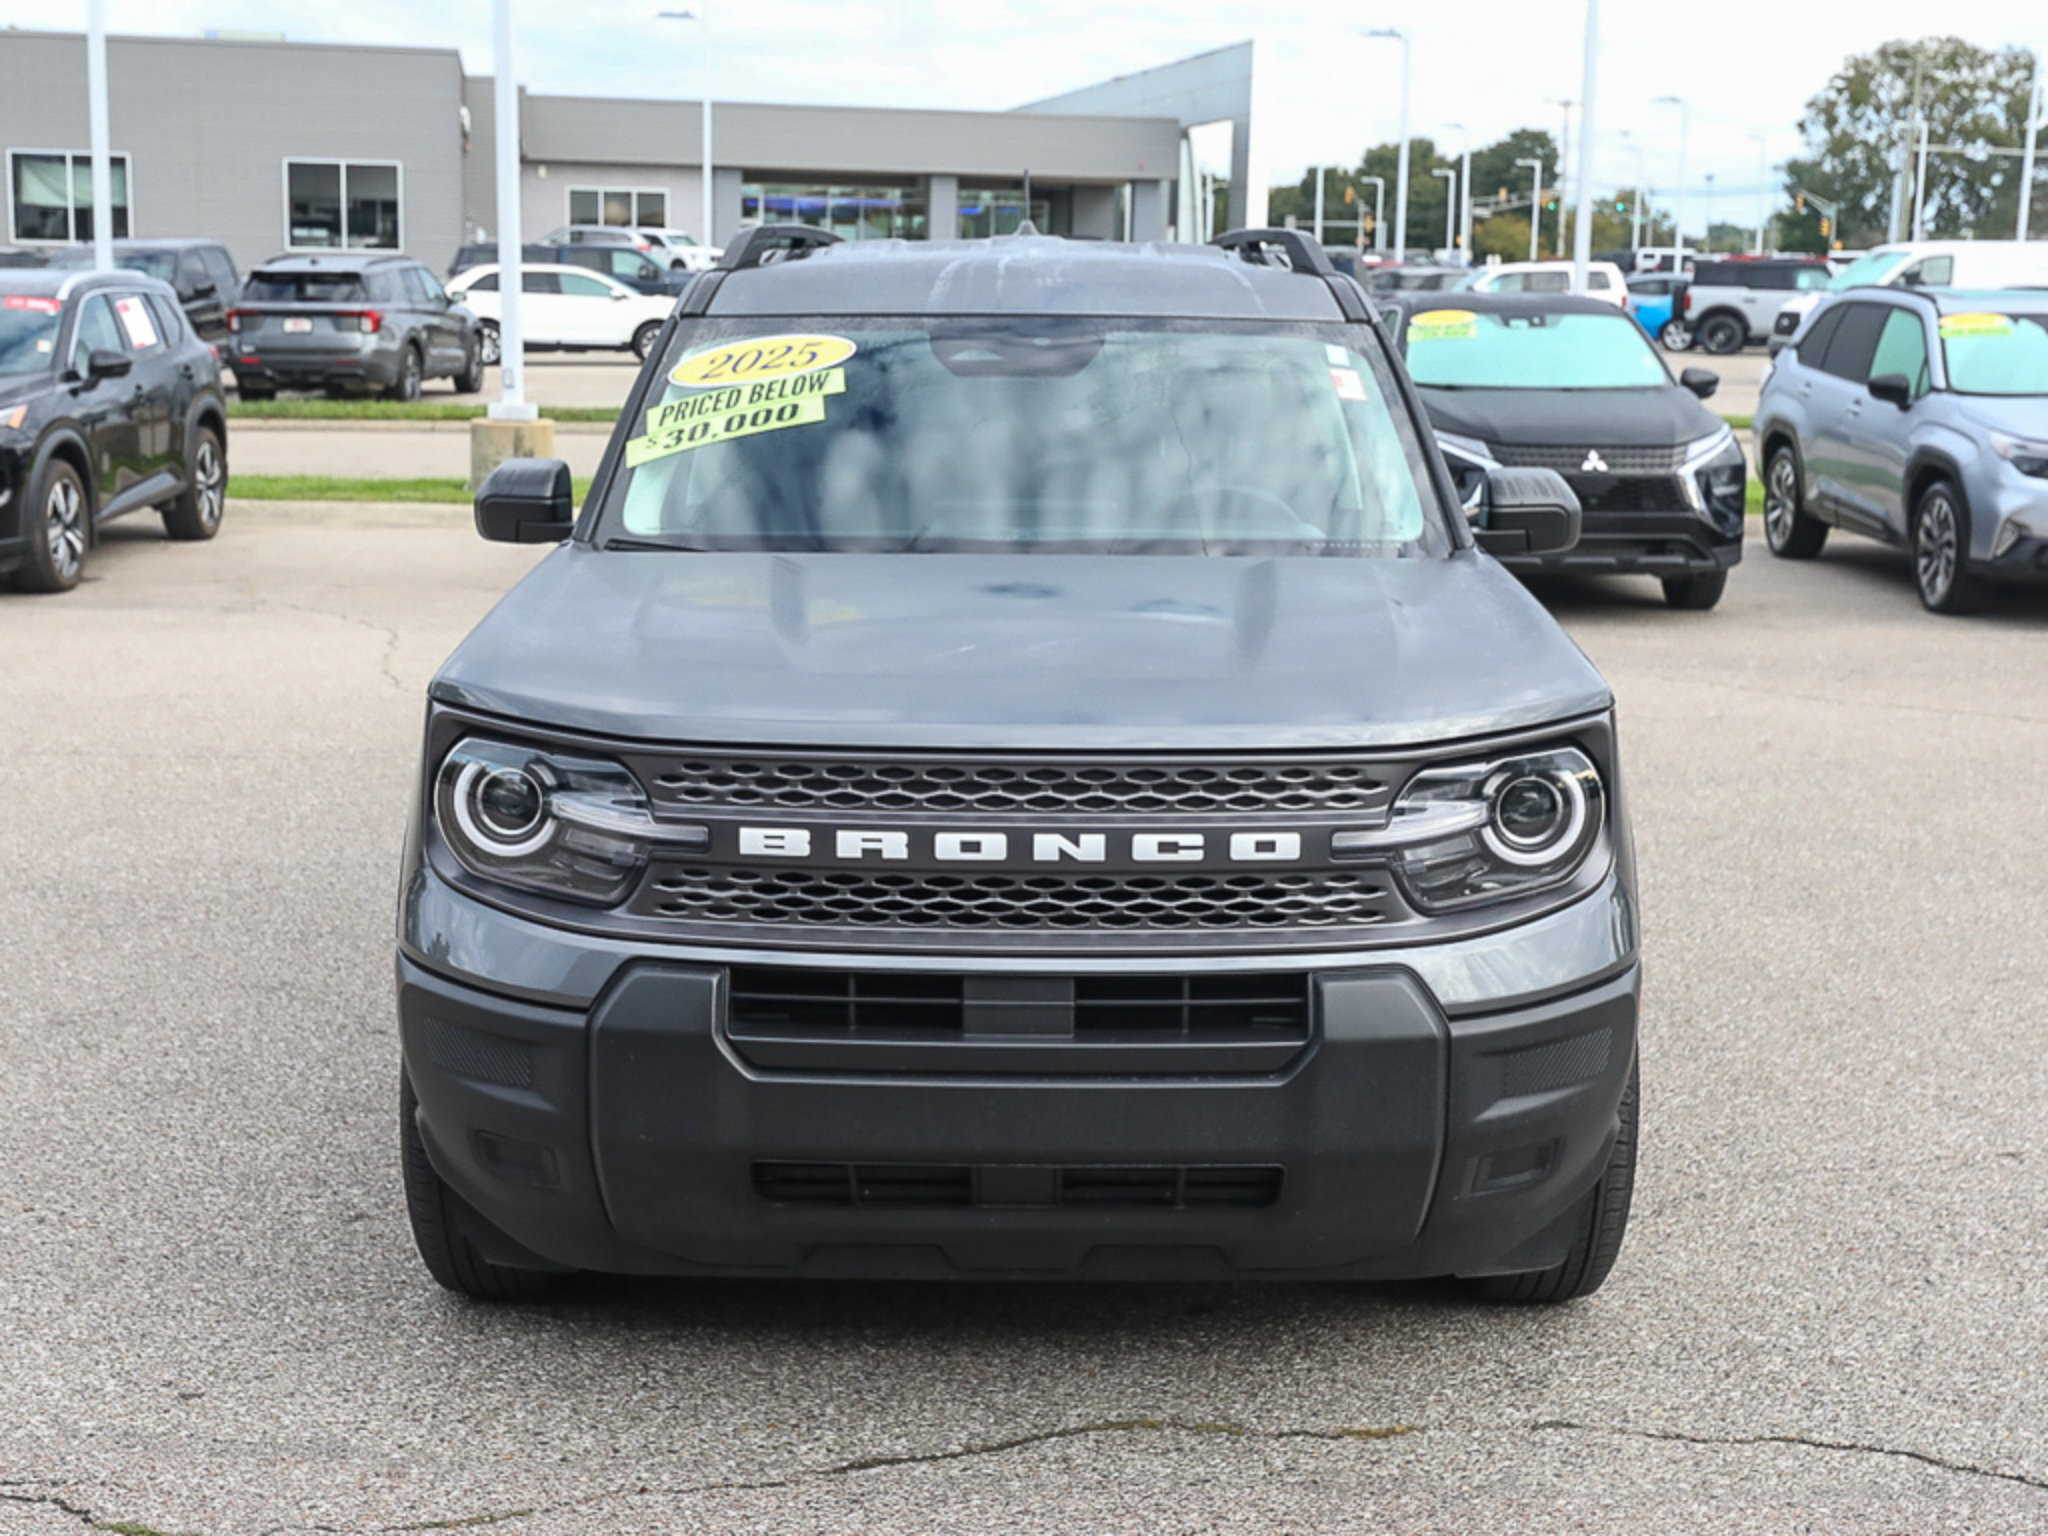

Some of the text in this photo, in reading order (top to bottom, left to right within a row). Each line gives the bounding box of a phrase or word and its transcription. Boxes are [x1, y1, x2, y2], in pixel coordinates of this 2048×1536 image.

[700, 342, 823, 380] 2025
[659, 372, 830, 427] PRICED BELOW
[739, 827, 1300, 861] BRONCO
